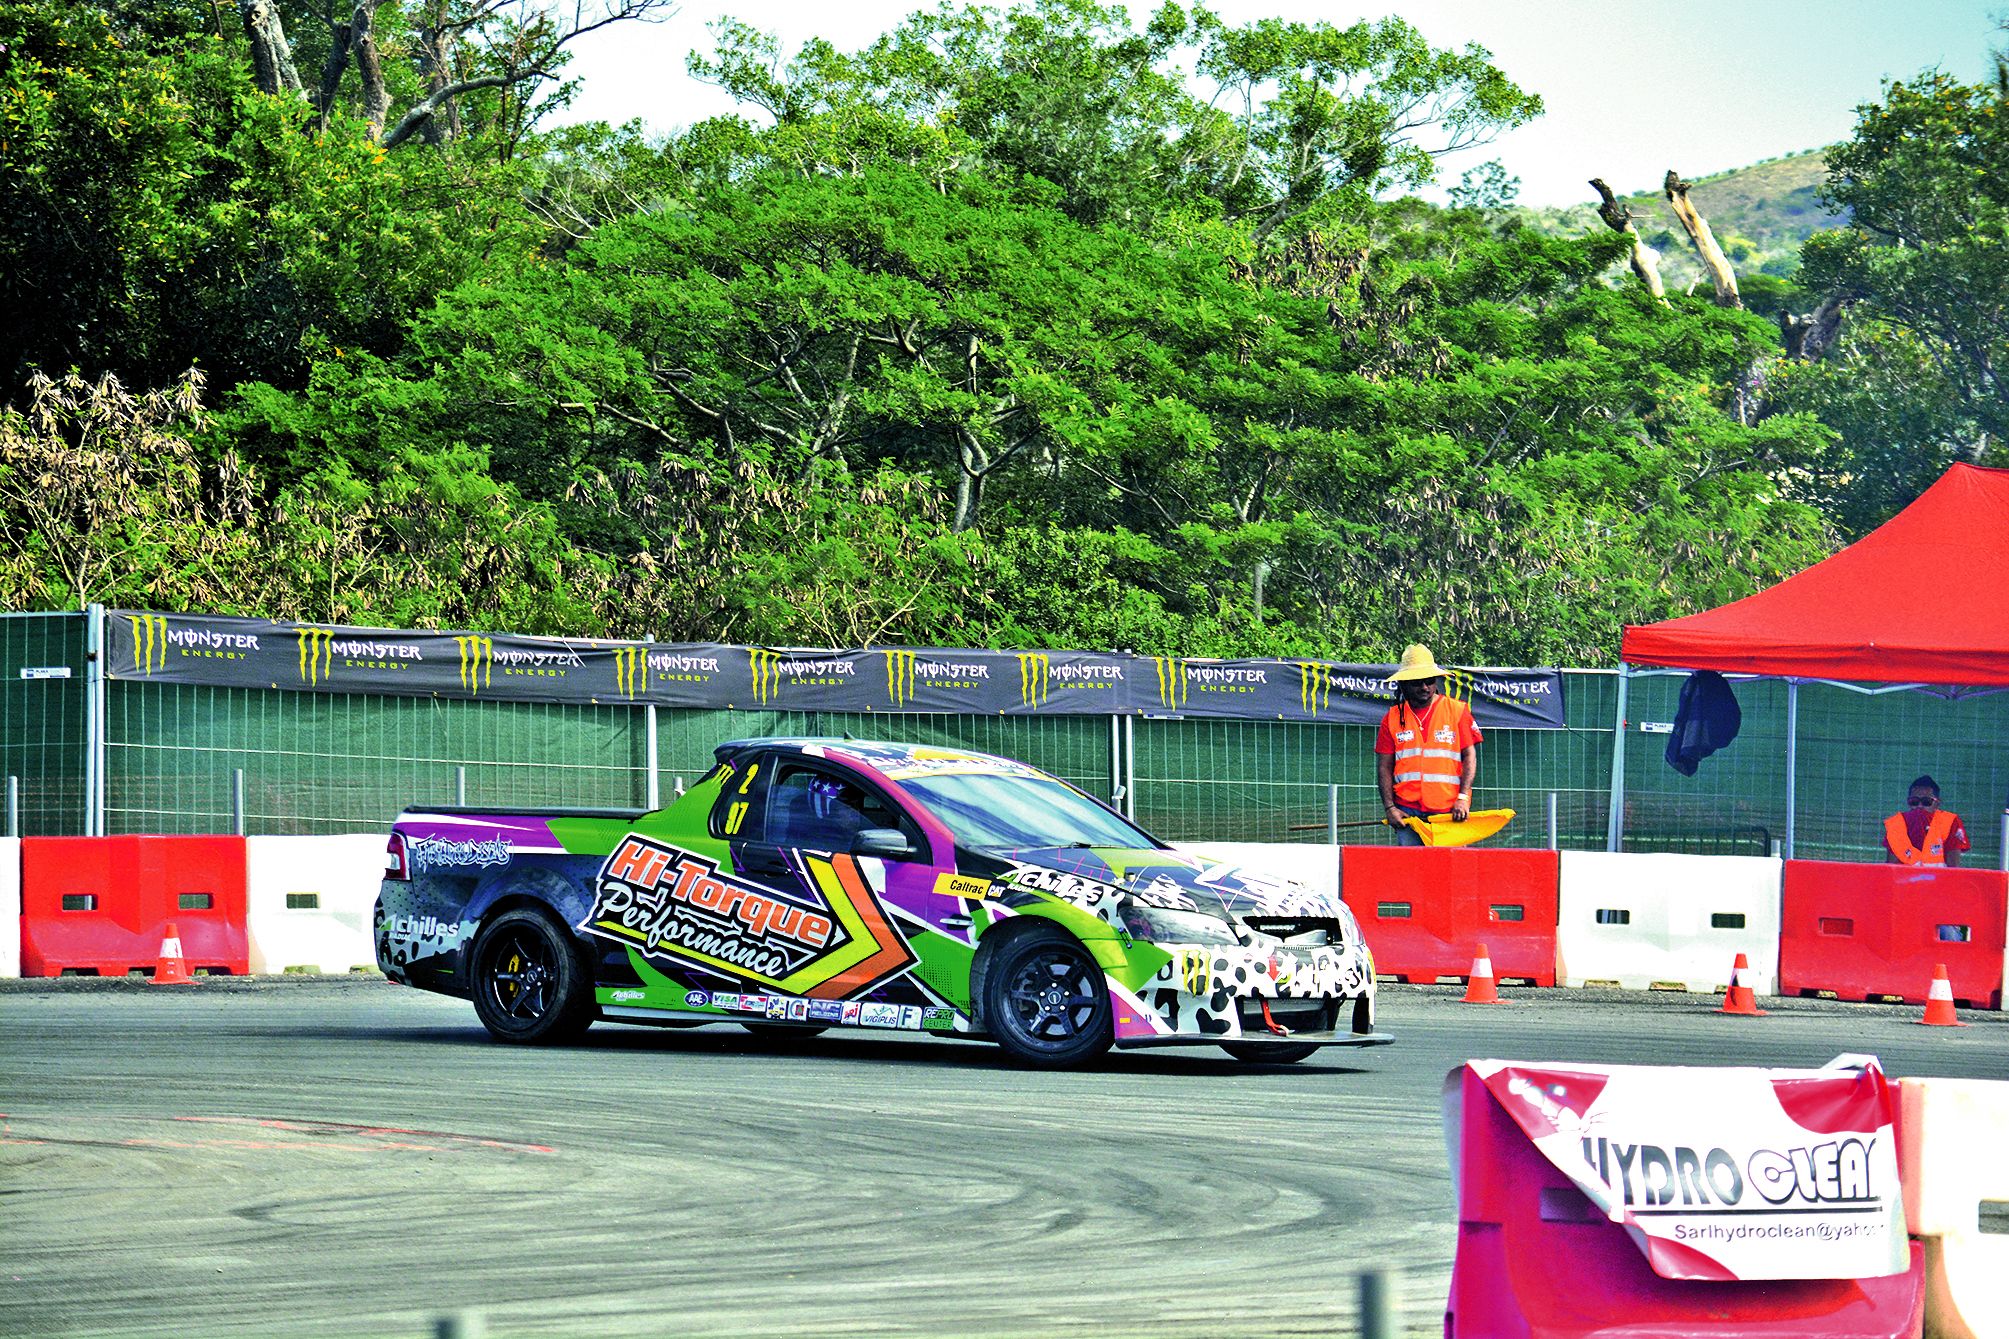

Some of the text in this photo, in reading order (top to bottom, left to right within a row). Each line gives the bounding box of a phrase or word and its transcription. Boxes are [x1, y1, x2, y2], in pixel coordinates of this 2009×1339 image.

[167, 628, 260, 651] MONSTER
[181, 648, 246, 660] ENERGY
[332, 640, 423, 661] MONSTER
[493, 650, 581, 667] MONSTER
[346, 659, 409, 670] ENERGY
[647, 653, 720, 673] MONSTER
[778, 659, 856, 676] MONSTER
[914, 661, 990, 679] MONSTER
[1049, 663, 1124, 680] MONSTER
[505, 668, 566, 677] ENERGY
[659, 674, 710, 682] ENERGY
[1187, 667, 1268, 684] MONSTER
[791, 677, 844, 686] ENERGY
[926, 680, 979, 689] ENERGY
[1059, 681, 1113, 689] ENERGY
[1200, 685, 1256, 693] ENERGY
[1330, 674, 1398, 691] MONSTE
[738, 764, 759, 794] 2
[725, 802, 750, 835] 97
[607, 840, 833, 949] Hi-Torque
[949, 879, 984, 895] Caltrac
[988, 883, 1006, 898] CAT
[379, 913, 459, 937] Achilles
[597, 881, 784, 976] Performance
[713, 994, 738, 1003] VISA
[865, 1015, 897, 1025] VIGIPLIS
[924, 1008, 956, 1020] REPRO
[1748, 1137, 1881, 1205] CLEA
